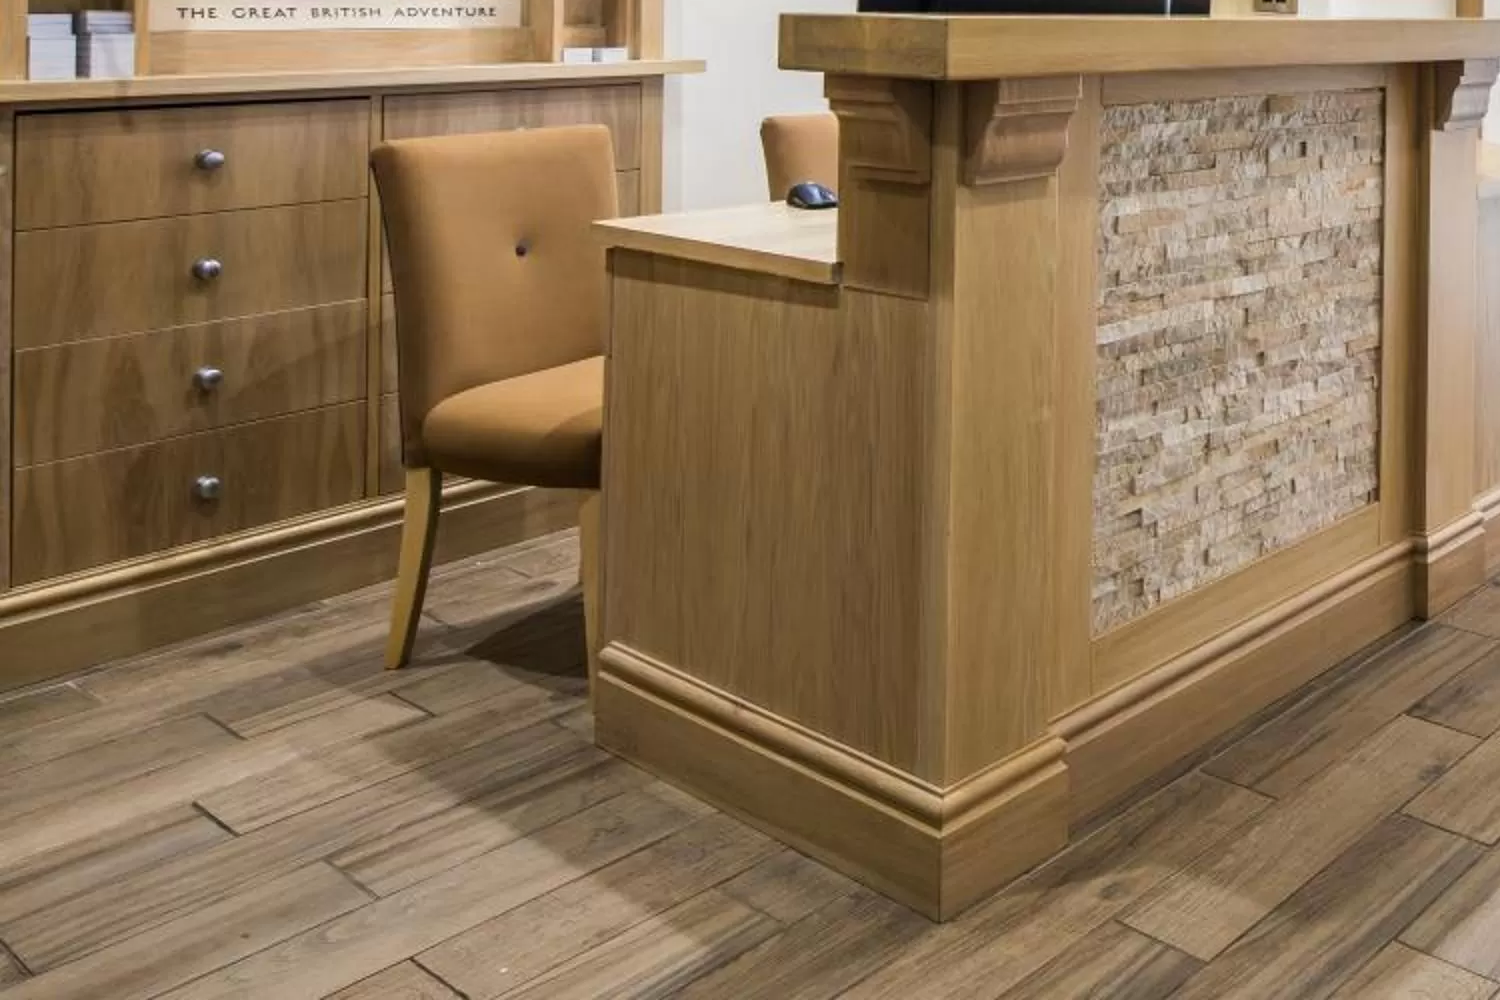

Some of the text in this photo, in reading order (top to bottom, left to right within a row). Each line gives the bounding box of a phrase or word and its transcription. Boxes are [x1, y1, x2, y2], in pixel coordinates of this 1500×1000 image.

[176, 6, 497, 19] THE GREAT BRITISH ADVENTURE
